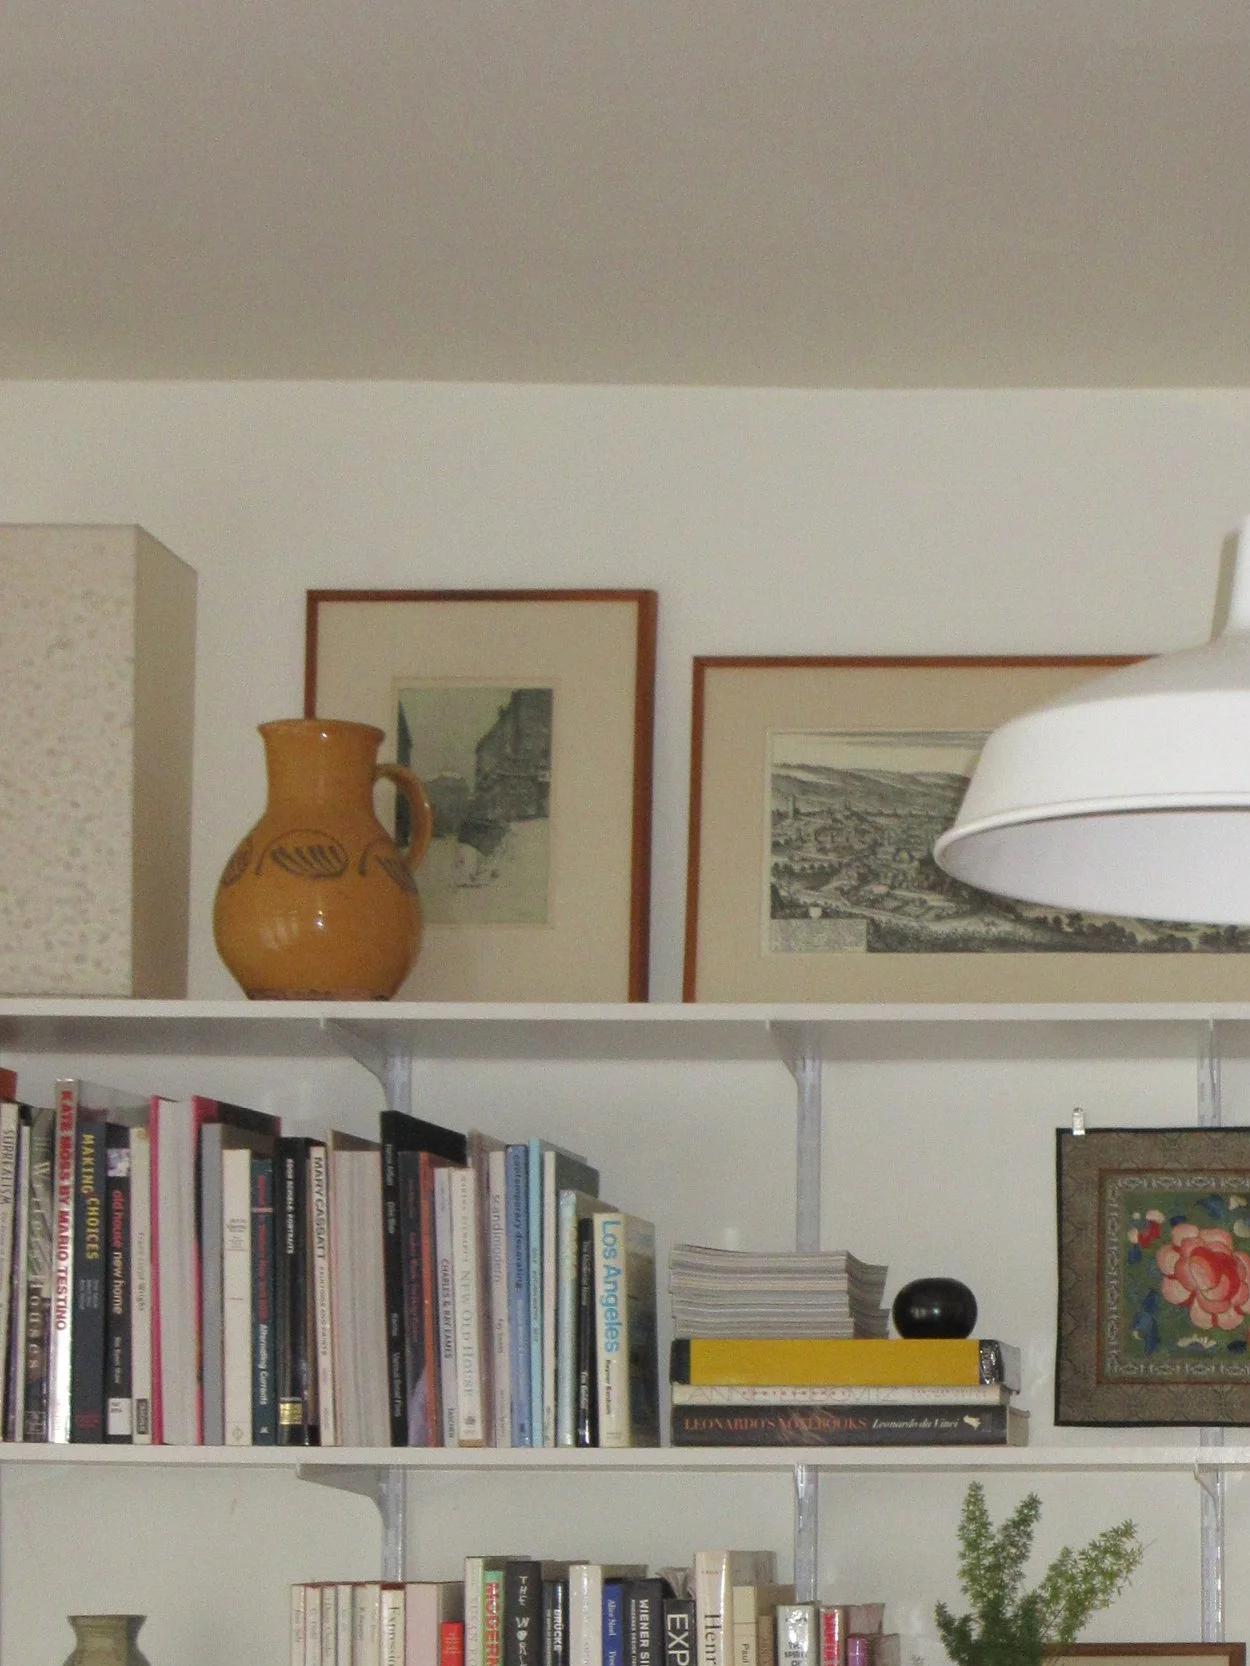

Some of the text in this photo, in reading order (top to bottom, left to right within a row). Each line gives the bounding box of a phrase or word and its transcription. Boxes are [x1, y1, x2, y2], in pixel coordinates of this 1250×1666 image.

[80, 1133, 96, 1194] MAKING
[55, 1090, 74, 1331] KATE MOSS BY MARIO TESTINO
[313, 1157, 327, 1261] MARY CASSATT
[512, 1153, 522, 1228] contemporary
[84, 1196, 100, 1260] CHOICES
[112, 1190, 123, 1315] old house new home
[441, 1258, 450, 1298] CHARLES
[599, 1220, 624, 1353] Los Angeles
[258, 1324, 268, 1368] Alternating
[443, 1329, 453, 1360] EAMES
[461, 1309, 474, 1342] OLD
[259, 1370, 268, 1404] Currents
[462, 1345, 475, 1396] HOUSE
[872, 1418, 918, 1429] Leonardo
[919, 1418, 931, 1429] da
[518, 1575, 528, 1607] THE
[607, 1599, 616, 1618] Alice
[553, 1609, 564, 1652] BRÜCKE
[607, 1619, 617, 1637] Neel
[639, 1599, 650, 1647] WIENER
[742, 1643, 750, 1663] Paul
